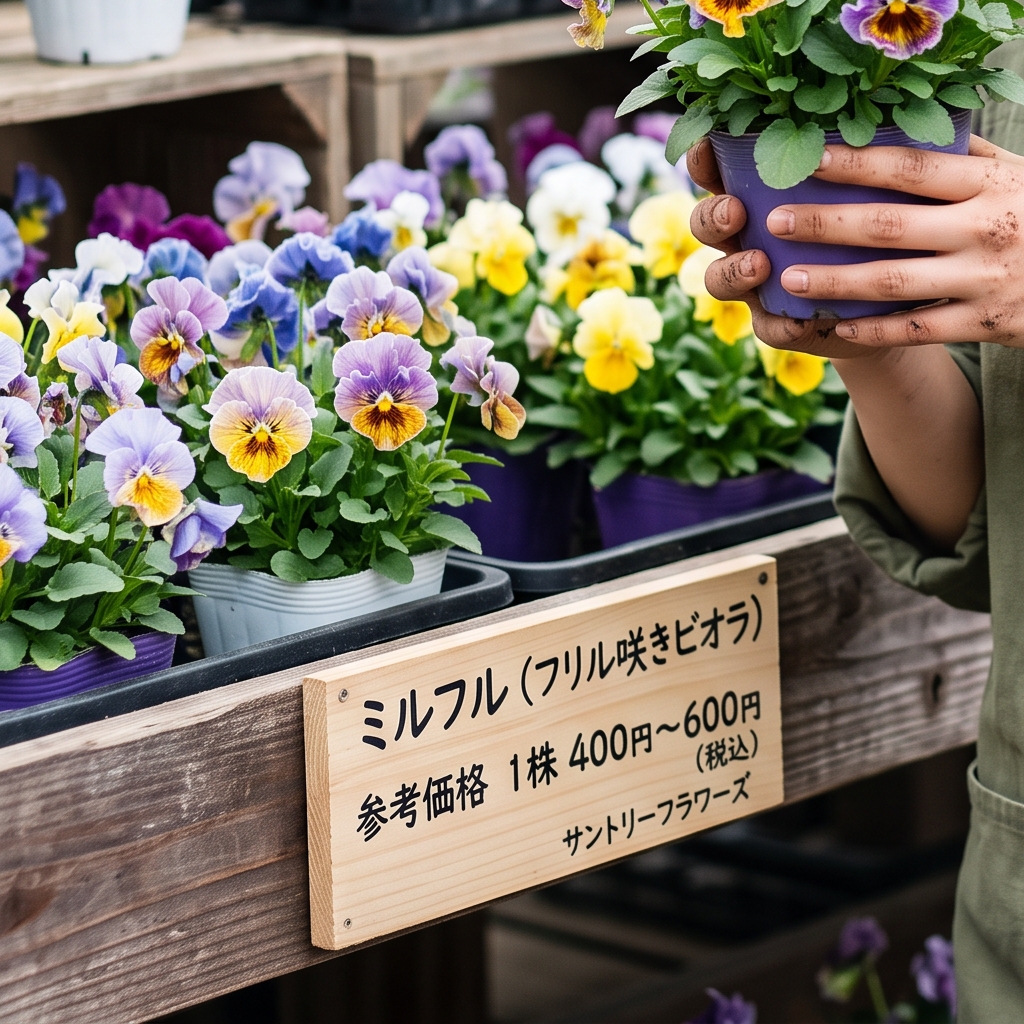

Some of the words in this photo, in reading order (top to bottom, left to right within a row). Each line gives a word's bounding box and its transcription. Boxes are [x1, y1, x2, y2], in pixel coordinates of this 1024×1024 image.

[356, 763, 489, 843] 参考価格
[509, 740, 559, 792] 1株
[696, 729, 759, 773] （税込）
[562, 771, 751, 857] サントリーフラワーズ
